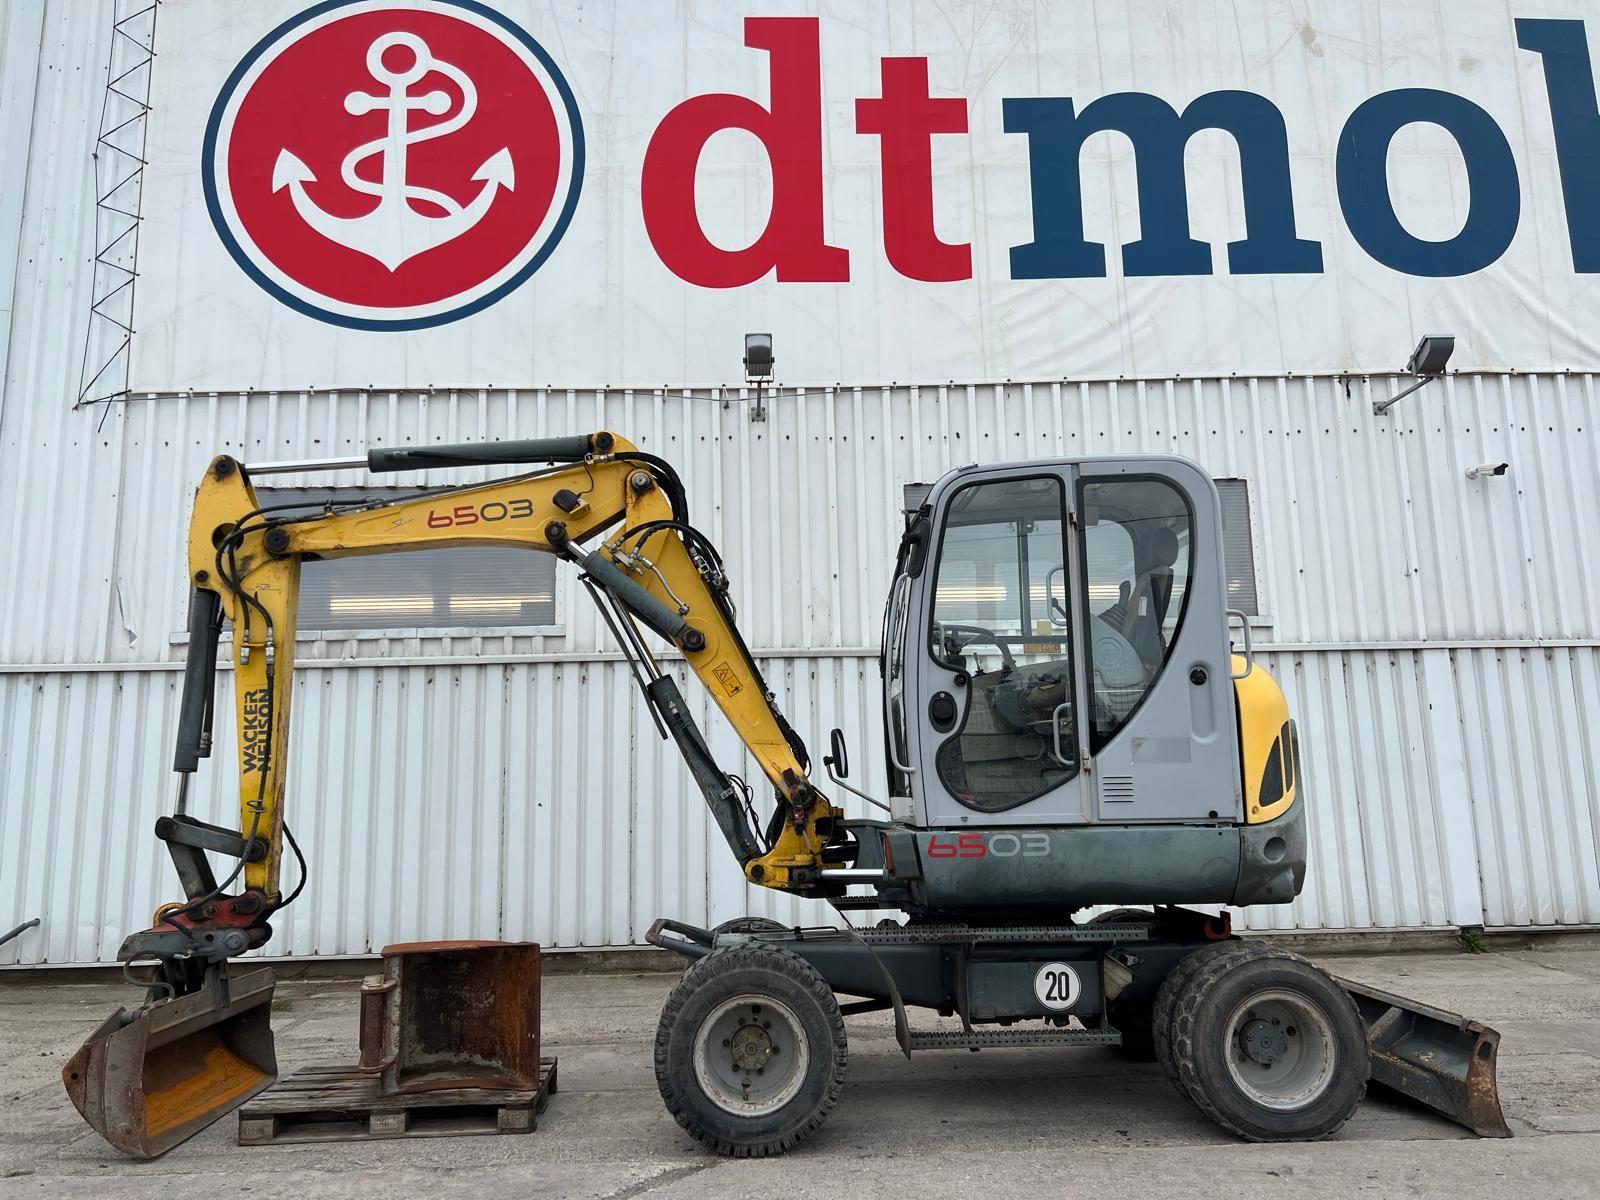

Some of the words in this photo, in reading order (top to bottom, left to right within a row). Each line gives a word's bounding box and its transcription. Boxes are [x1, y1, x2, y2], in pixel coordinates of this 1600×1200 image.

[427, 499, 534, 529] 6503
[243, 689, 258, 774] WACKER
[927, 833, 1051, 858] 6503
[1045, 971, 1070, 1001] 20
